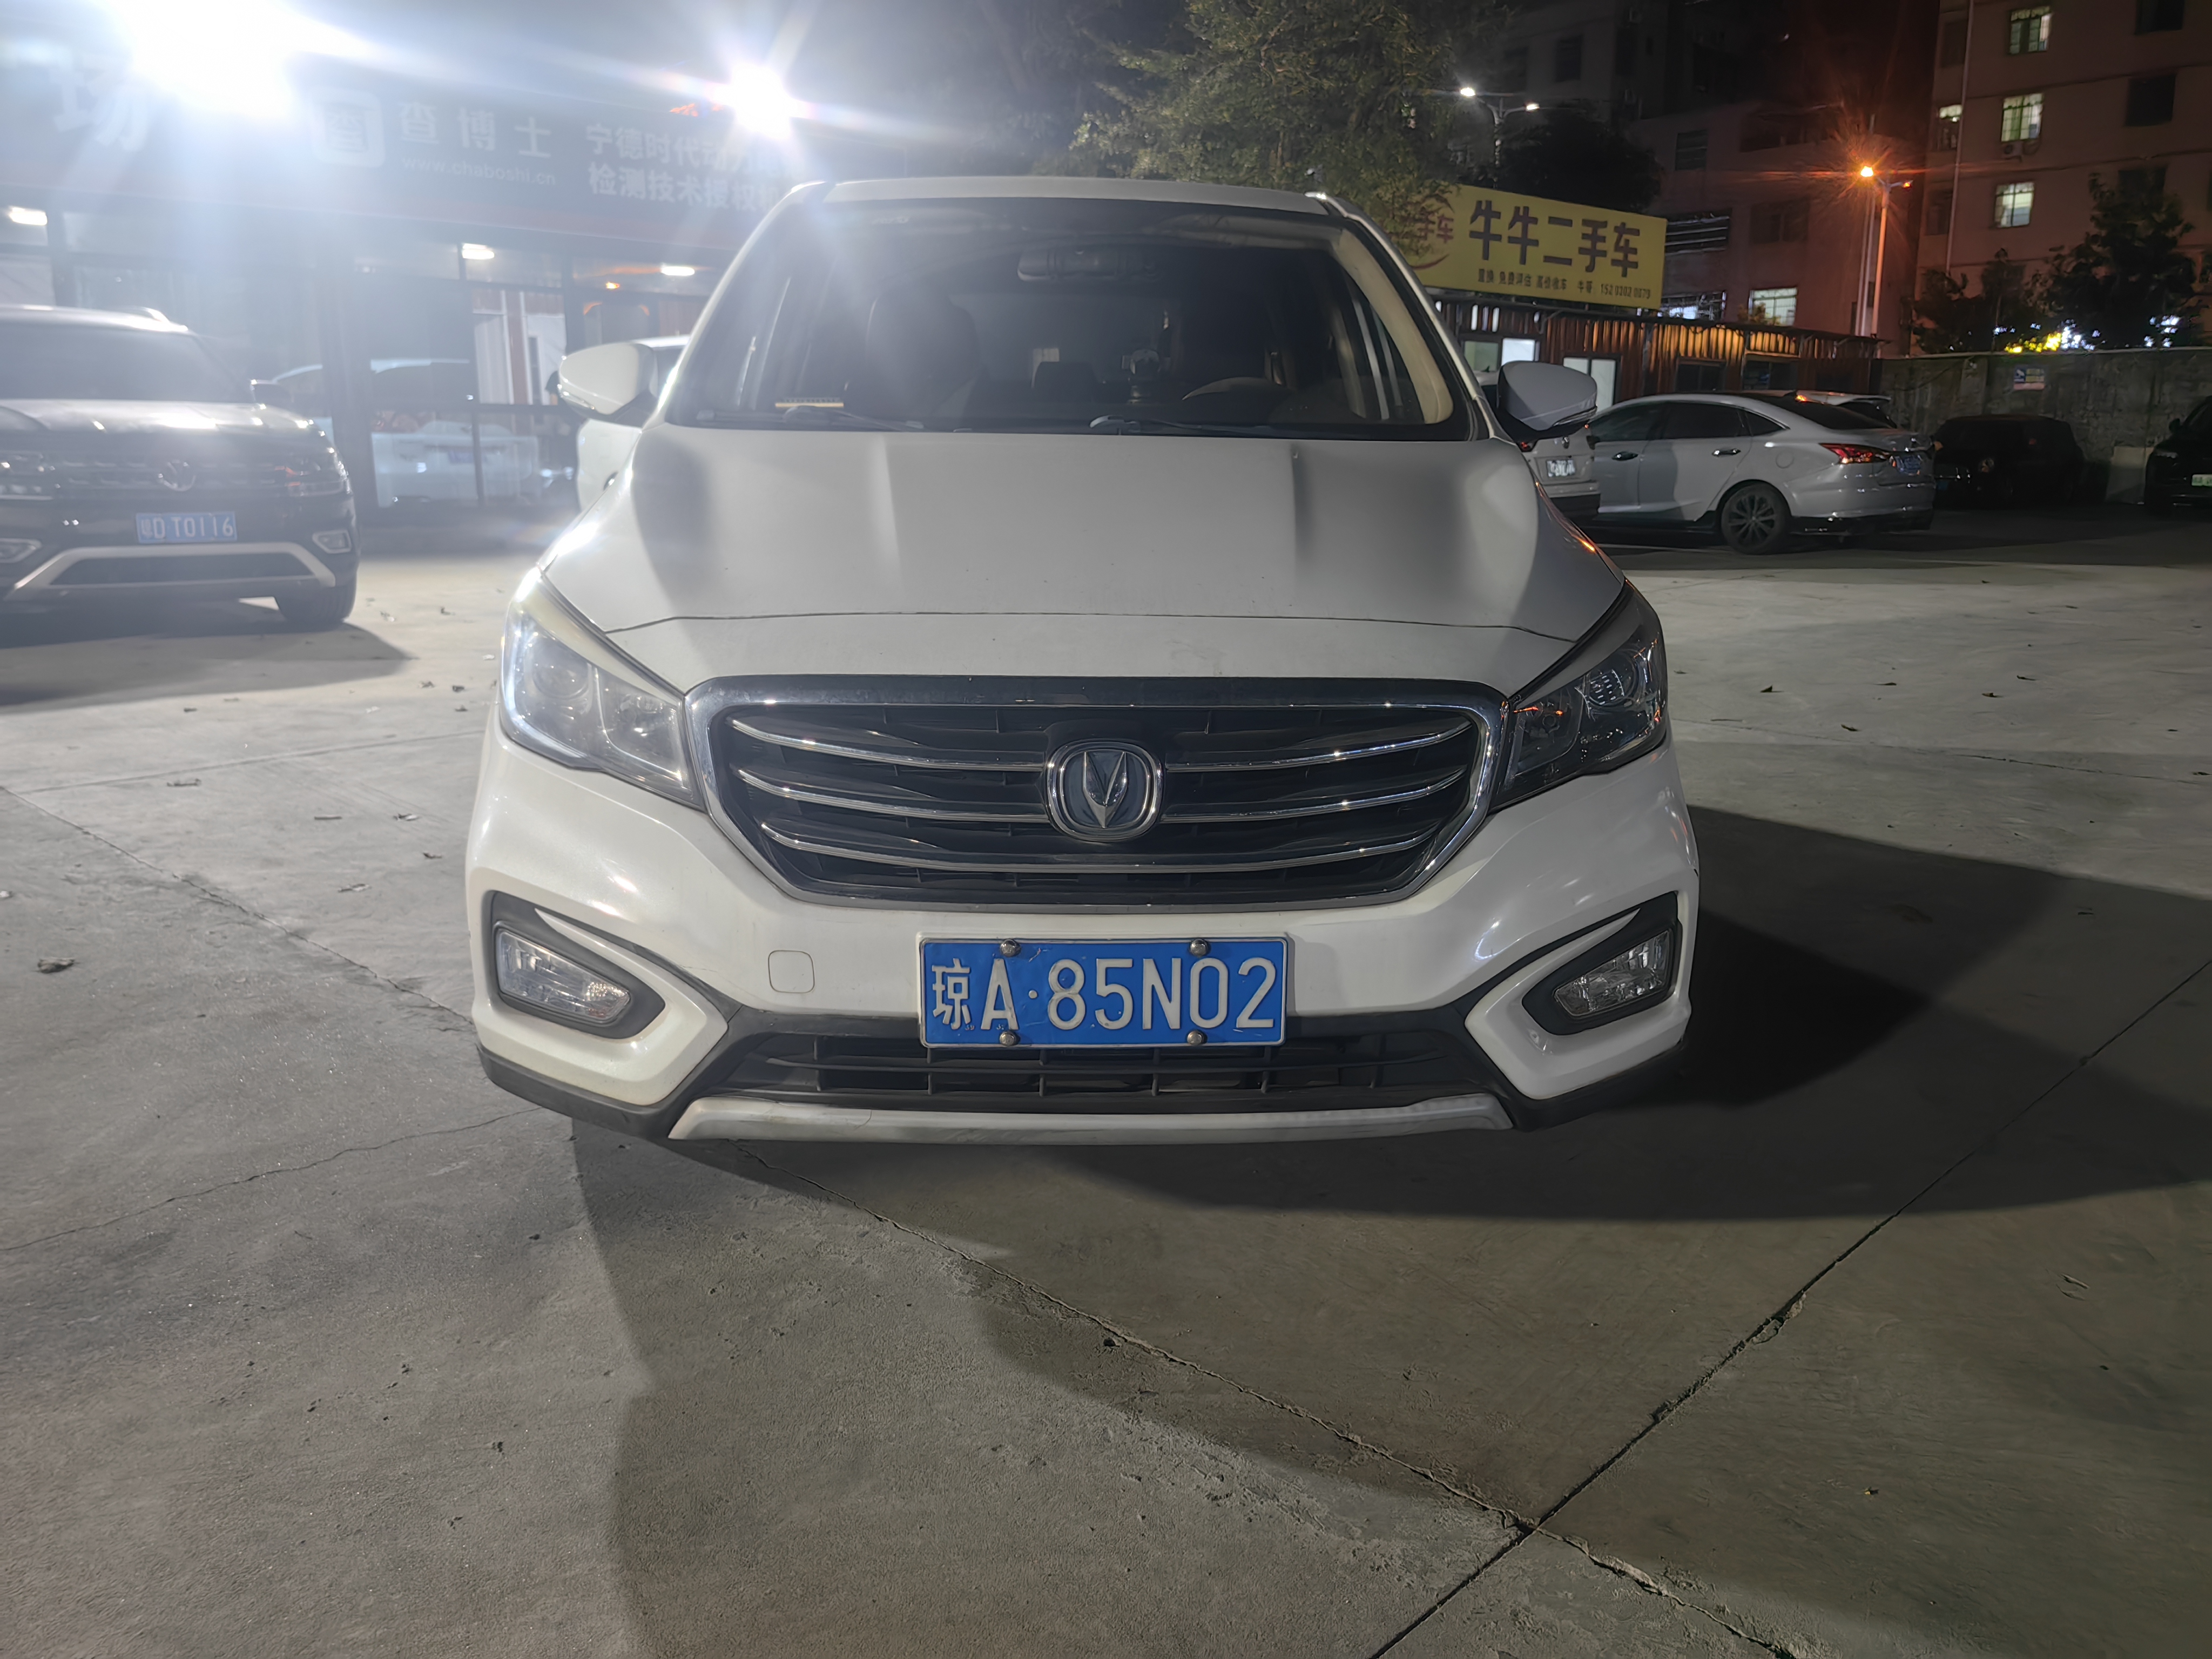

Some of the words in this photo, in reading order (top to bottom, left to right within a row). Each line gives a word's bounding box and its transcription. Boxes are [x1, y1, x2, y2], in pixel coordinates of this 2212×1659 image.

[396, 100, 552, 159] 查博士
[401, 154, 556, 186] www.chaboshi.cn
[1468, 200, 1641, 278] 牛牛二手车
